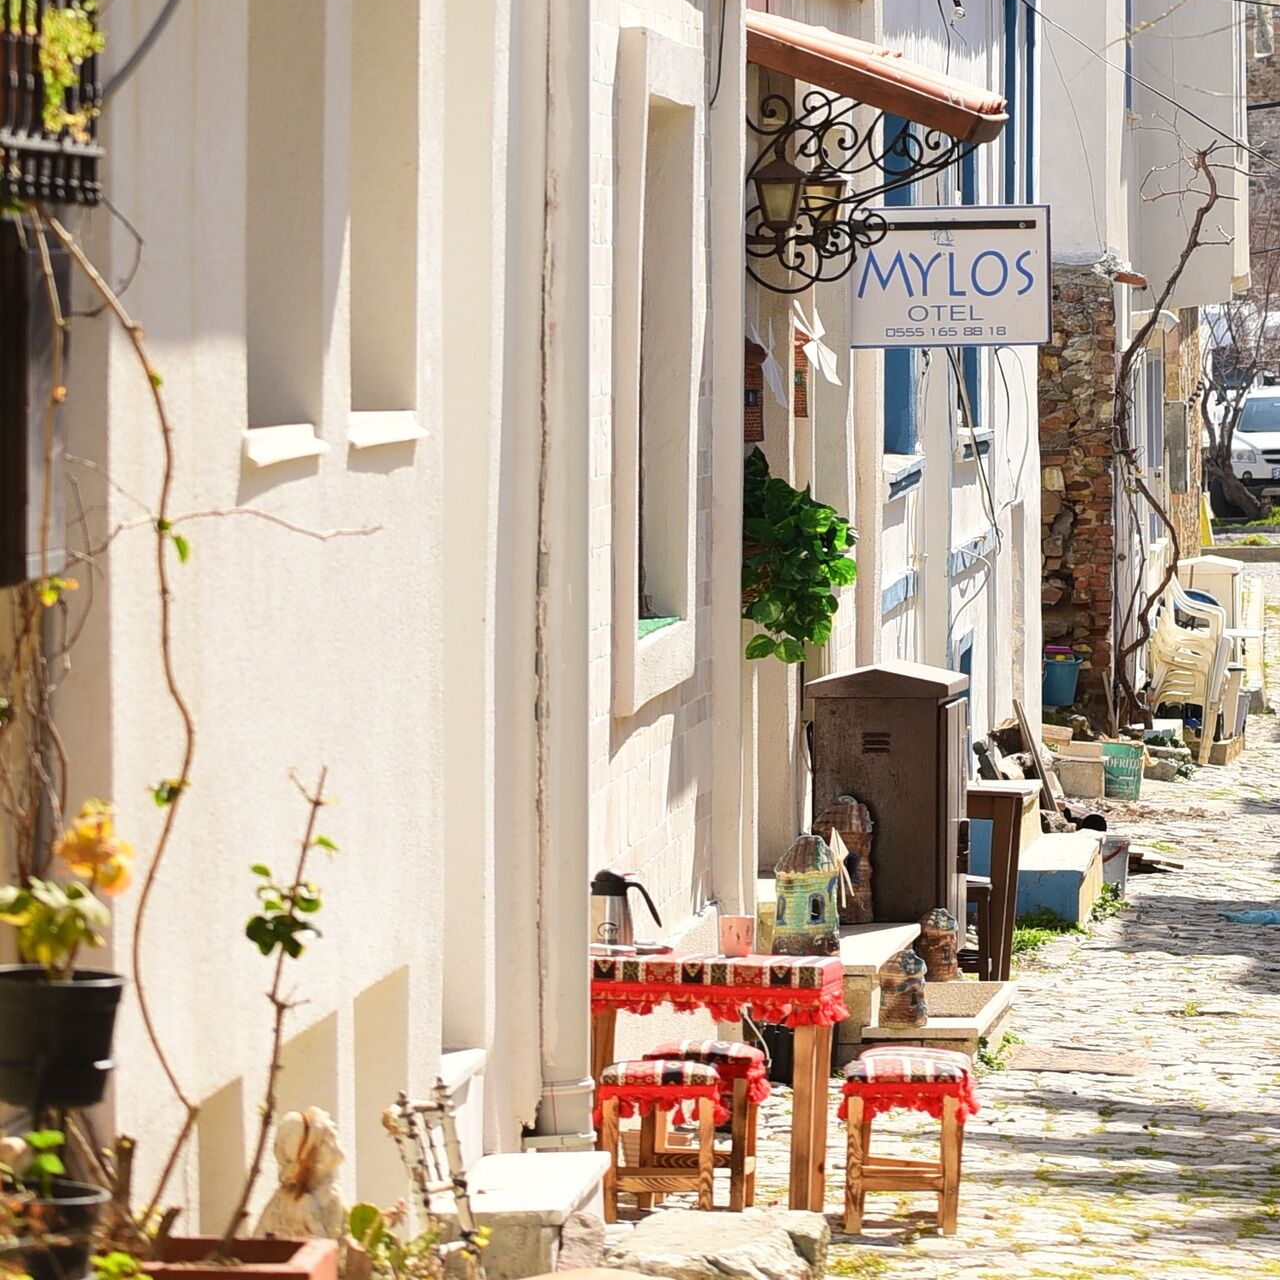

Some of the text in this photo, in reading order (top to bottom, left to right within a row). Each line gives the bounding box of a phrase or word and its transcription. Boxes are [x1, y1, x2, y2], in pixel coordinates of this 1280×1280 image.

[857, 248, 1035, 299] MYLOS
[907, 304, 984, 322] OTEL
[930, 326, 958, 337] 165
[963, 326, 983, 337] 88
[989, 325, 1007, 336] 18
